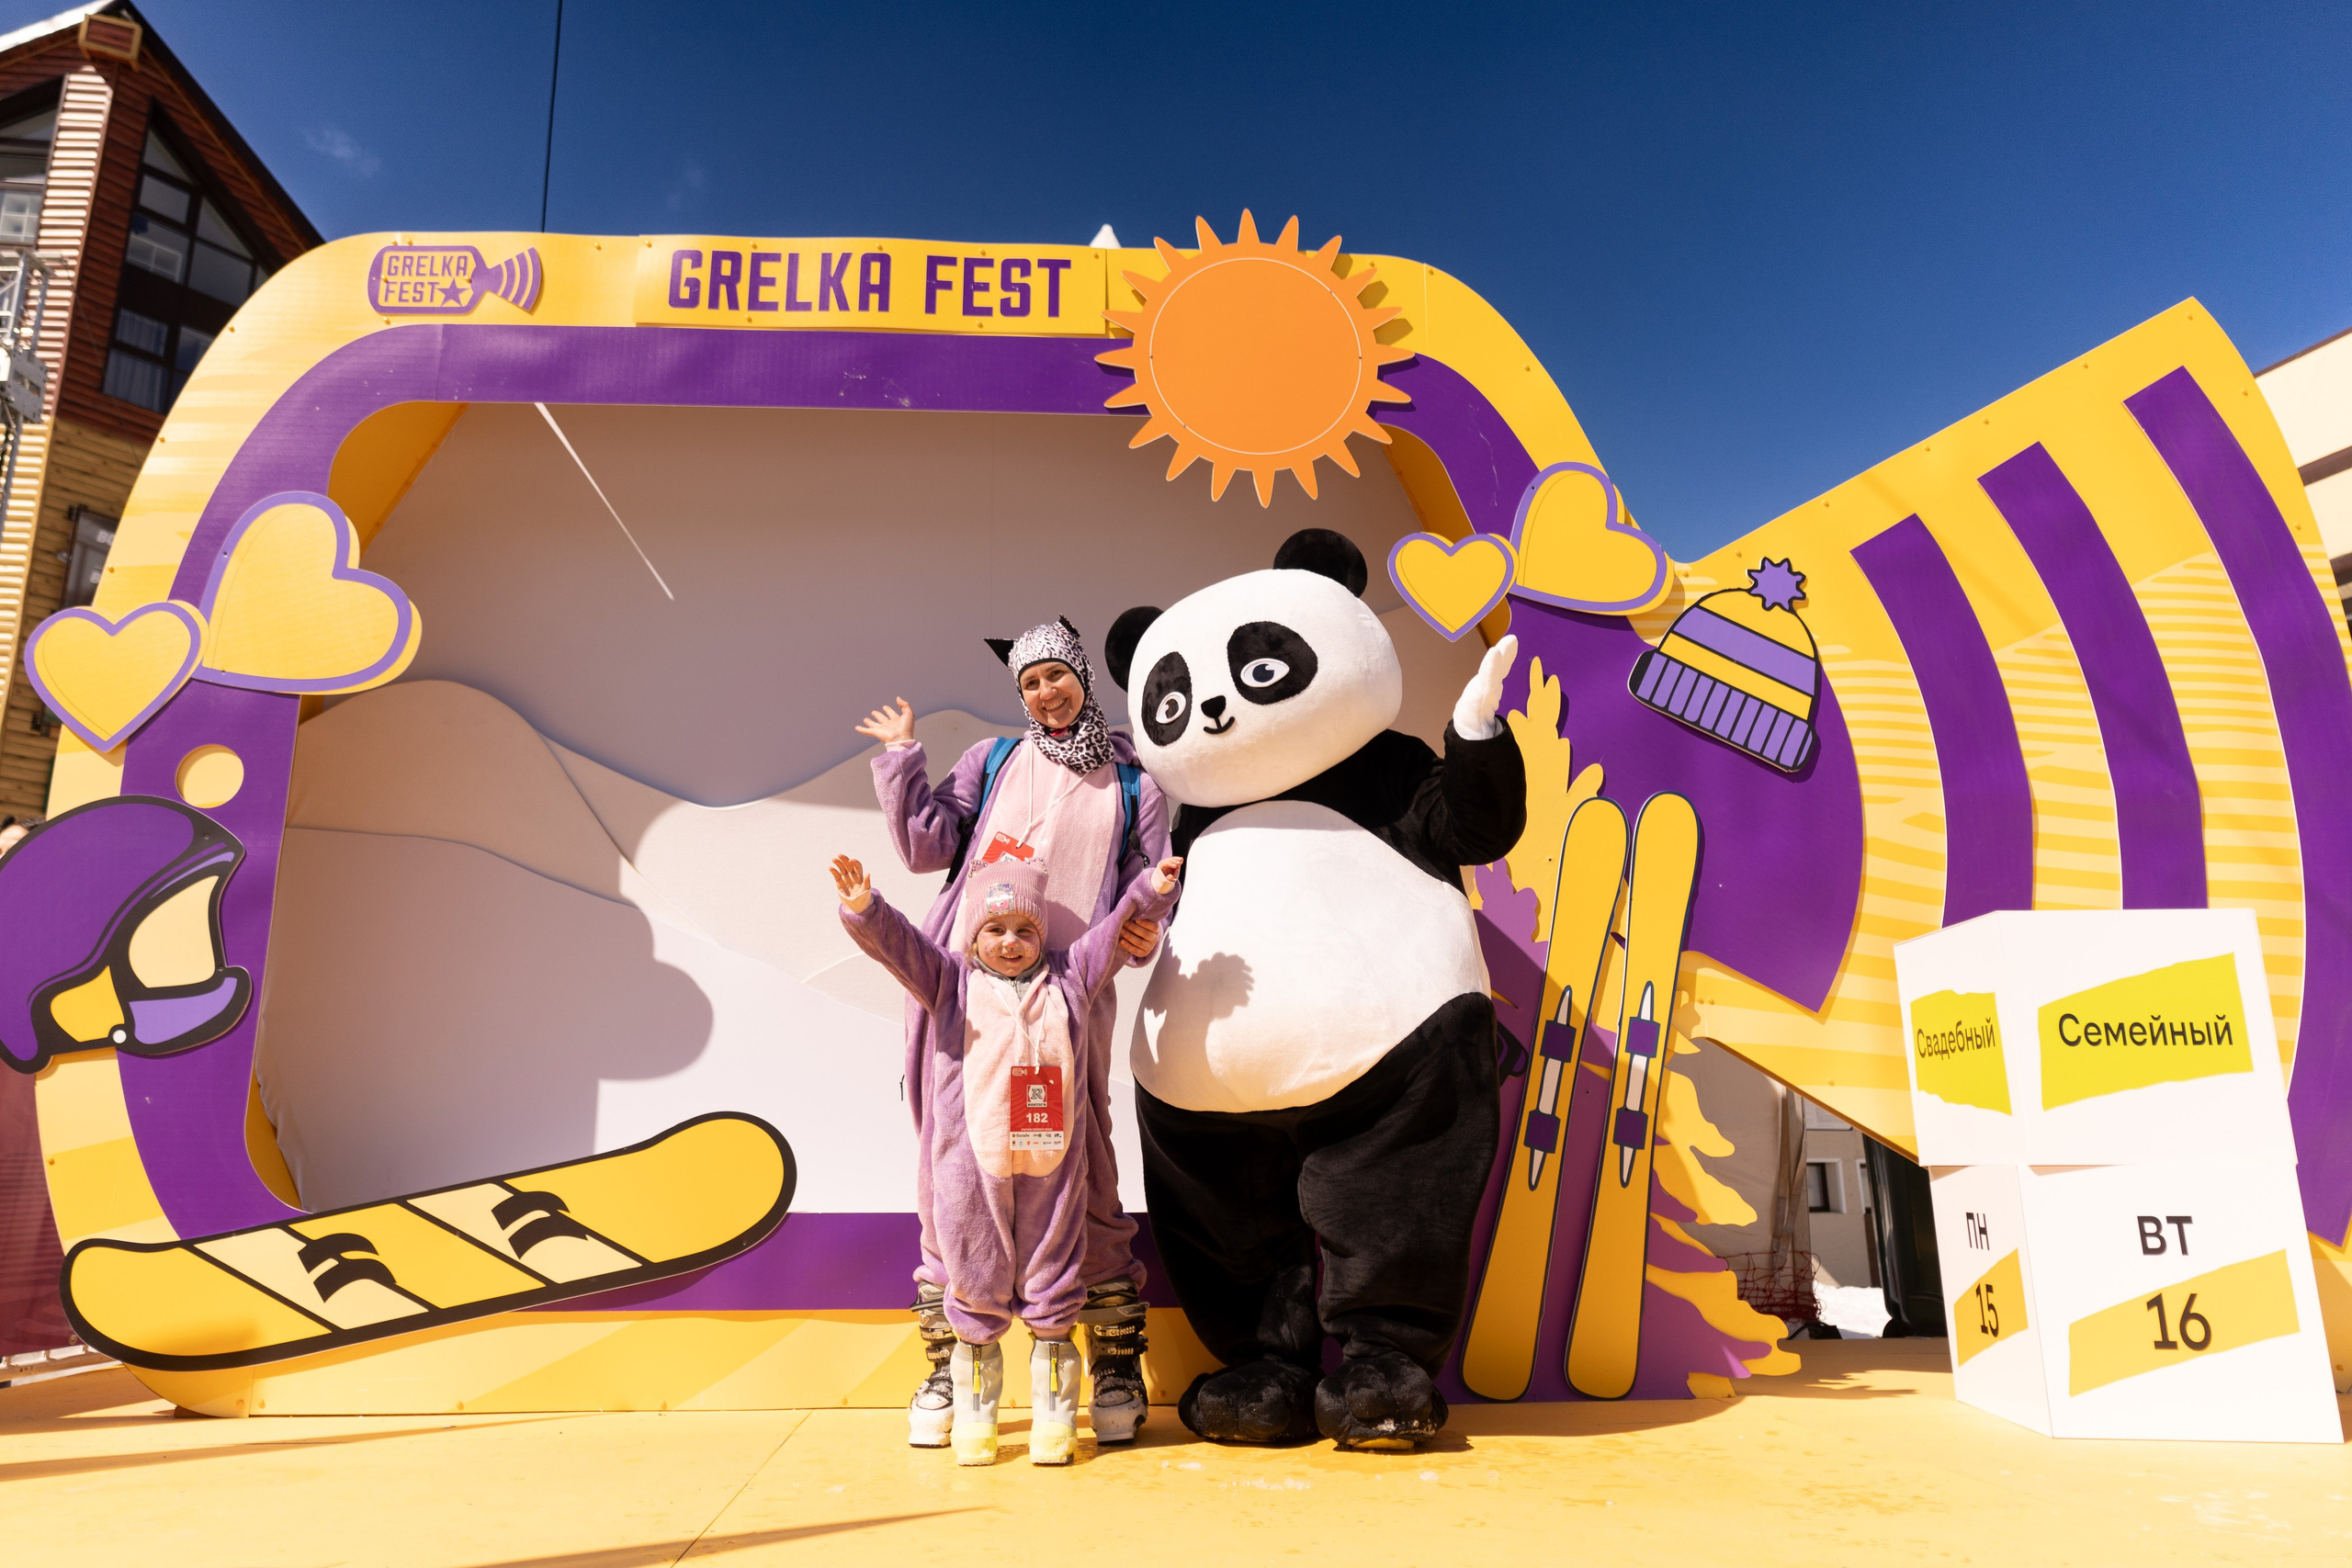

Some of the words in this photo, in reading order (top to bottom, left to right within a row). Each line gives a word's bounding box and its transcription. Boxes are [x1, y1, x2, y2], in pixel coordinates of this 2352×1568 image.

[387, 255, 469, 276] GRELKA
[668, 249, 891, 312] GRELKA
[924, 255, 1072, 318] FEST
[384, 281, 440, 303] FEST
[1917, 1017, 1996, 1060] Свадебный
[2058, 1013, 2233, 1047] Семейный
[1026, 1112, 1048, 1123] 182
[1974, 1282, 2000, 1338] 15
[2145, 1292, 2212, 1351] 16
